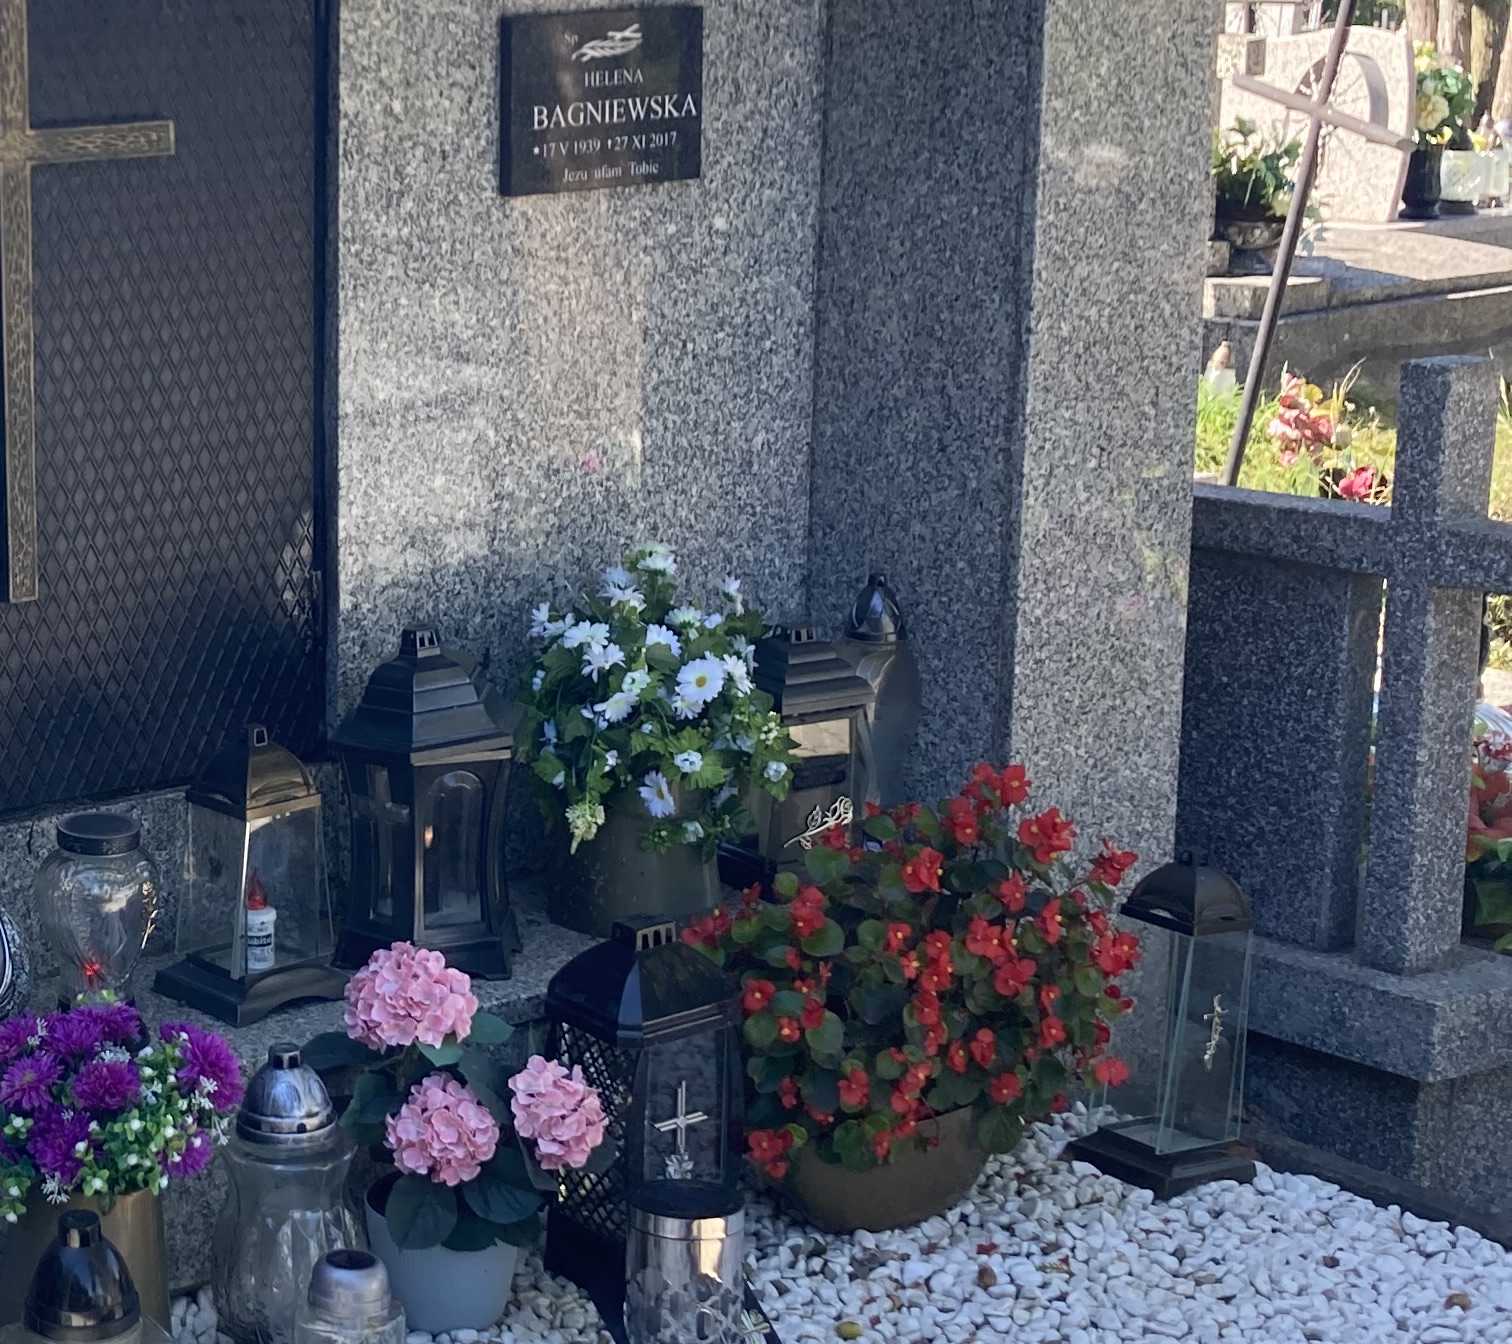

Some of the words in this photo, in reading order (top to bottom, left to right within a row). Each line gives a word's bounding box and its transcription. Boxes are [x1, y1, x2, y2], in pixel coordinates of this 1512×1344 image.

[584, 68, 644, 88] HELENA
[533, 93, 698, 131] BAGNIEWSKA
[559, 142, 569, 156] V
[573, 140, 601, 156] 1939
[614, 136, 629, 150] 27
[650, 132, 678, 148] 2017
[563, 168, 588, 183] Jezu
[629, 160, 659, 175] Tobie
[247, 936, 272, 945] ubito
